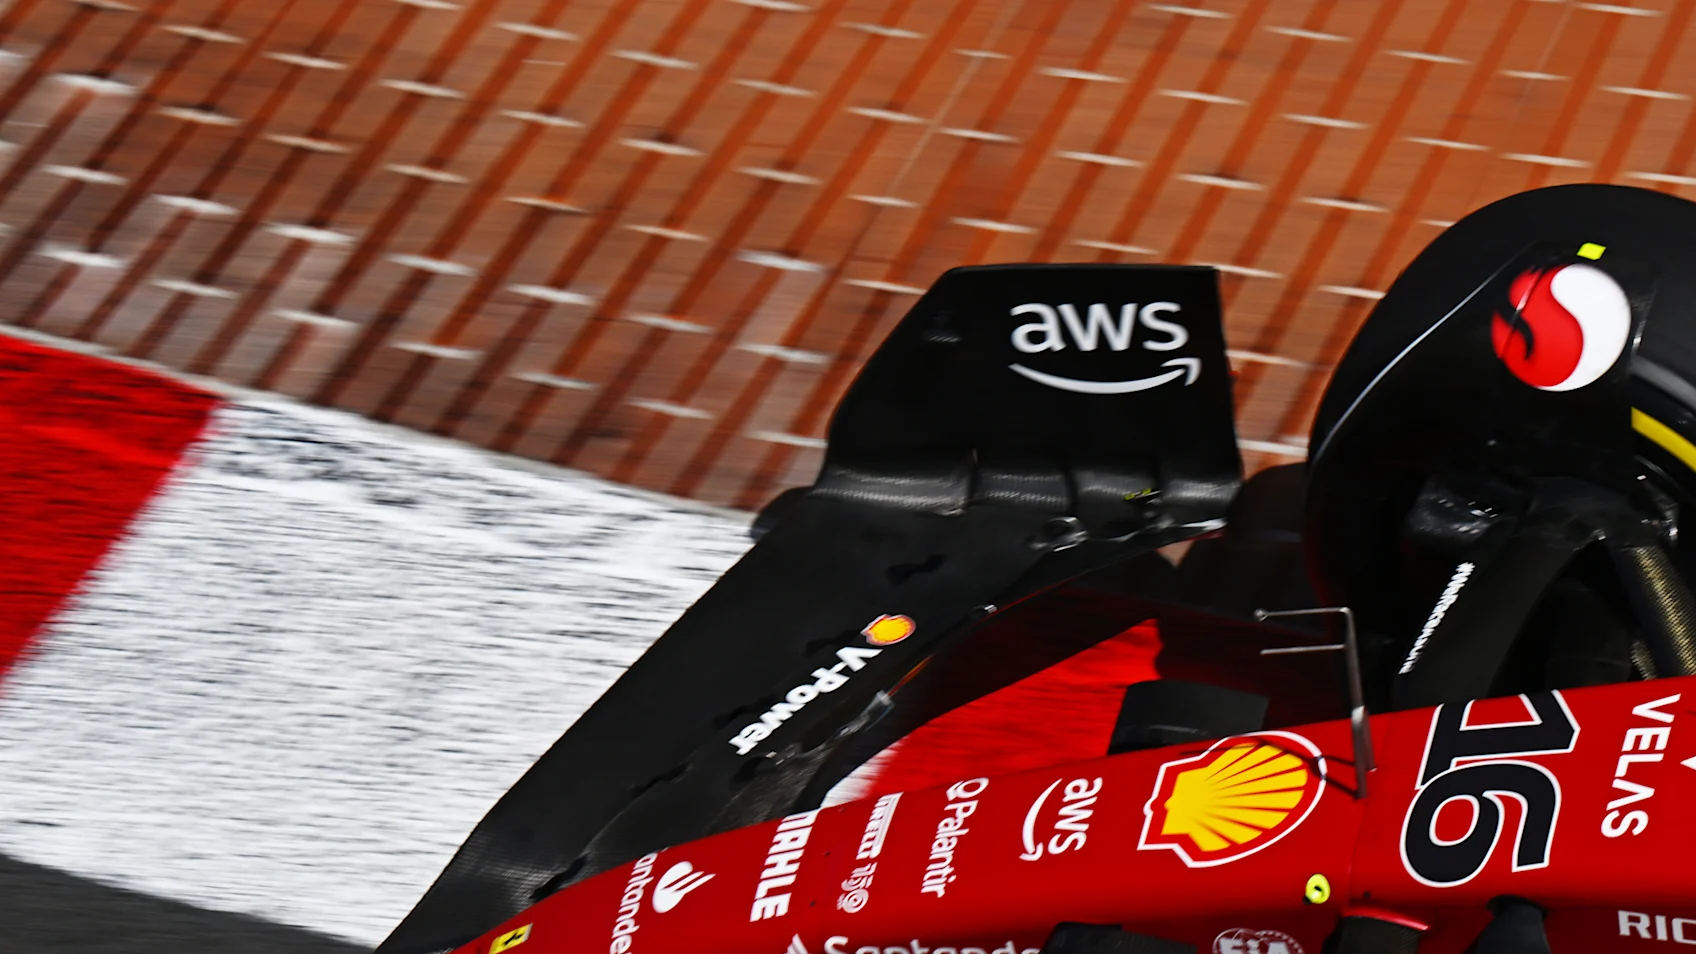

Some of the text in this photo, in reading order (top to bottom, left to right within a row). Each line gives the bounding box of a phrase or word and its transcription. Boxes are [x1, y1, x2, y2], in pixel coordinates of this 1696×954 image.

[1011, 302, 1187, 352] aws
[728, 645, 882, 754] V-Power
[1048, 777, 1104, 855] aws
[1400, 690, 1581, 887] 16
[1600, 693, 1682, 838] VELAS
[920, 800, 979, 898] Palantir
